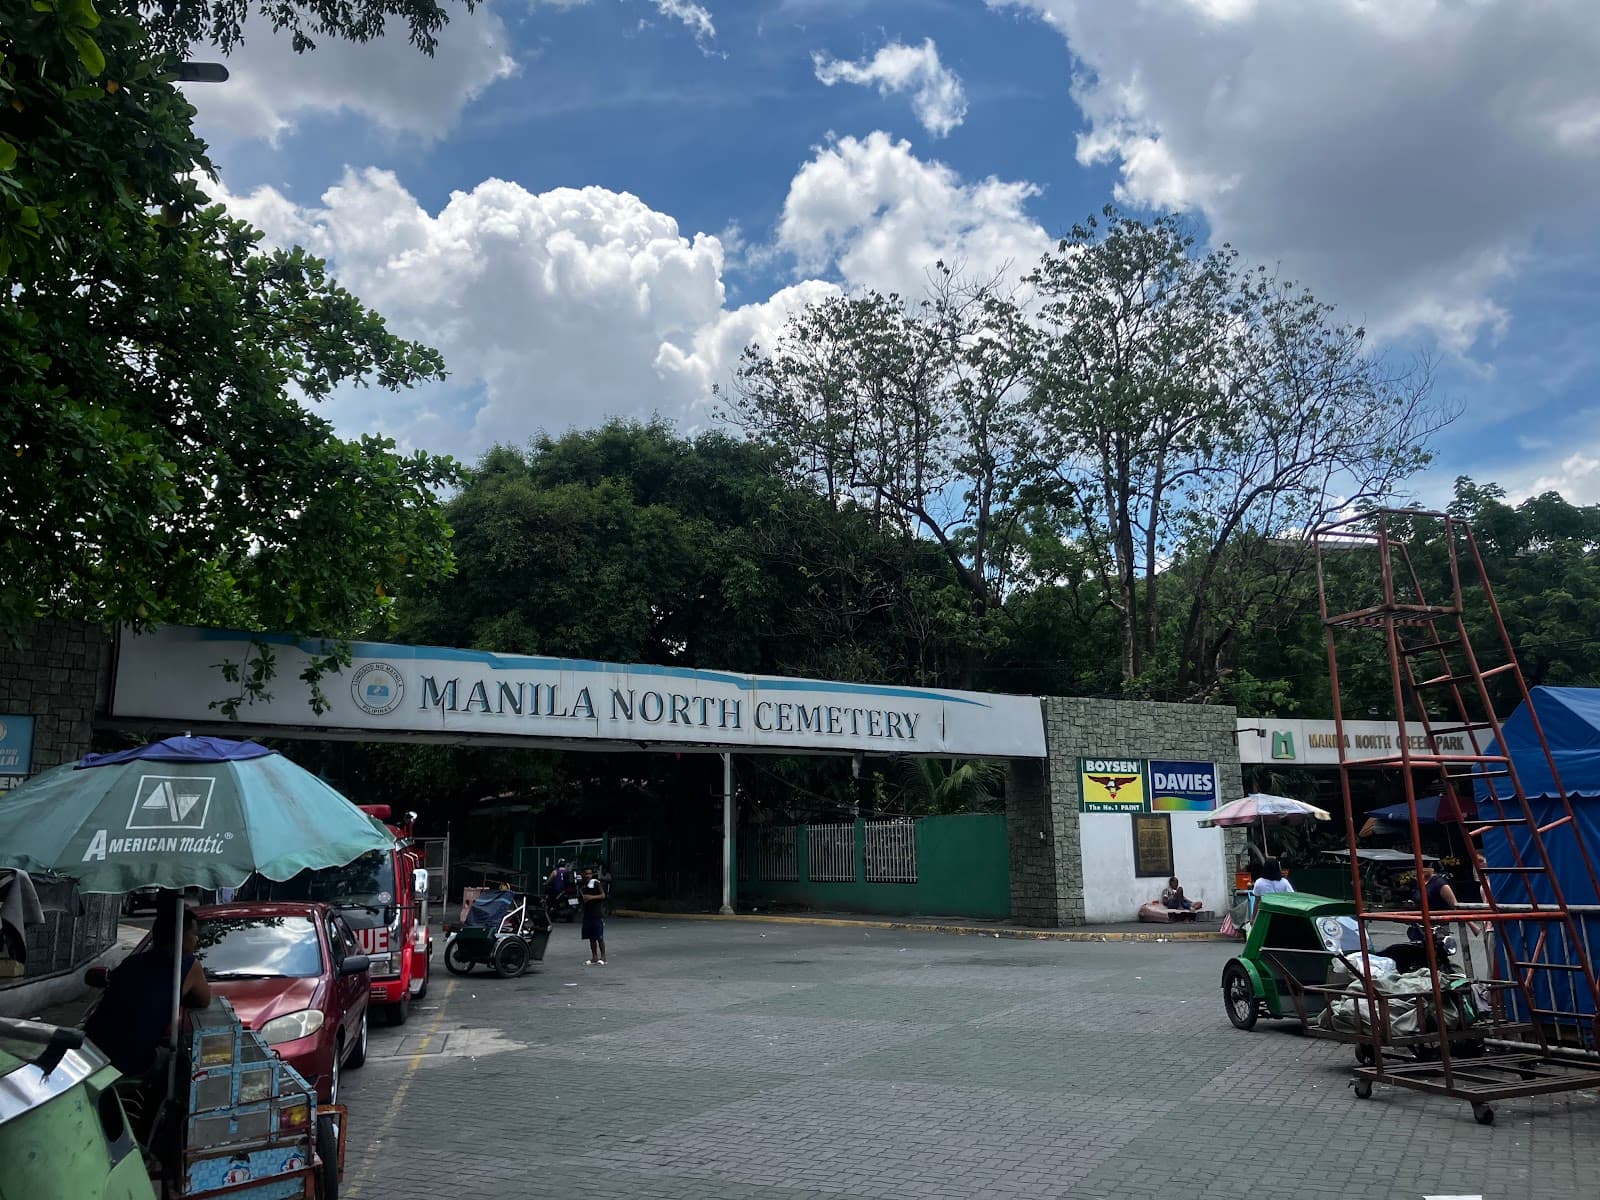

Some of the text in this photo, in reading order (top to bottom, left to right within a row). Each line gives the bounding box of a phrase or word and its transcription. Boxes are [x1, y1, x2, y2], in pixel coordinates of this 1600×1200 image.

[418, 675, 921, 739] MANILA NORTH CEMETERY
[1355, 734, 1392, 749] NORTH
[1436, 735, 1465, 751] PARK
[1085, 760, 1138, 773] BOYSEN
[1154, 772, 1213, 791] DAVIES
[82, 829, 178, 862] AMERICAN
